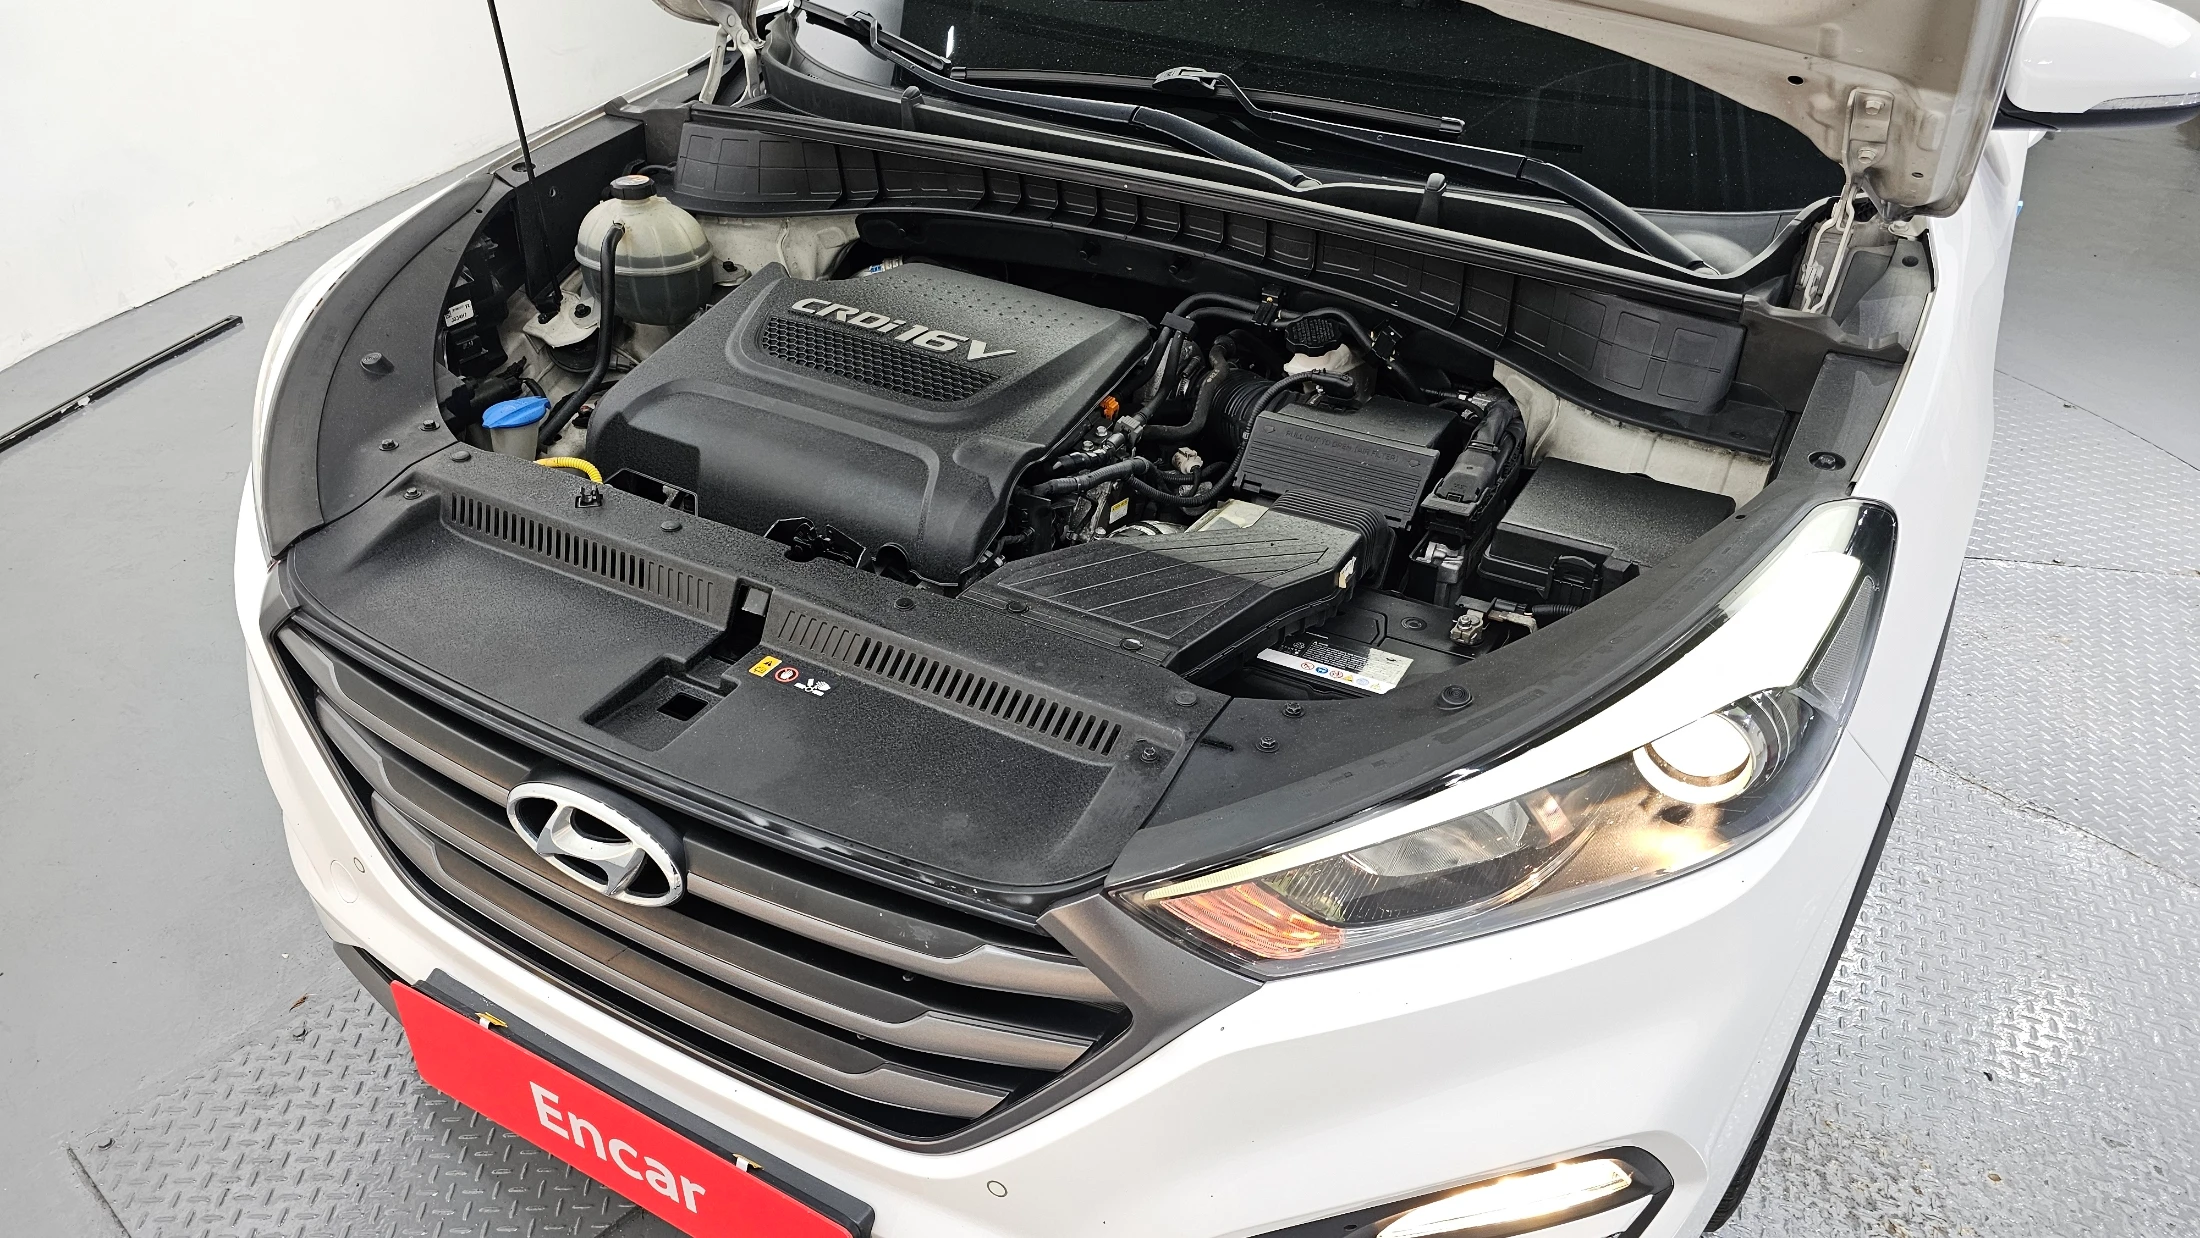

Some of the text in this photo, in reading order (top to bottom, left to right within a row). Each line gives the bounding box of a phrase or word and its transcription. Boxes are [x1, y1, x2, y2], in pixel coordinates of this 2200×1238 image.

[1305, 434, 1321, 444] OUT
[1321, 437, 1331, 446] TO
[529, 1081, 706, 1214] Encar
